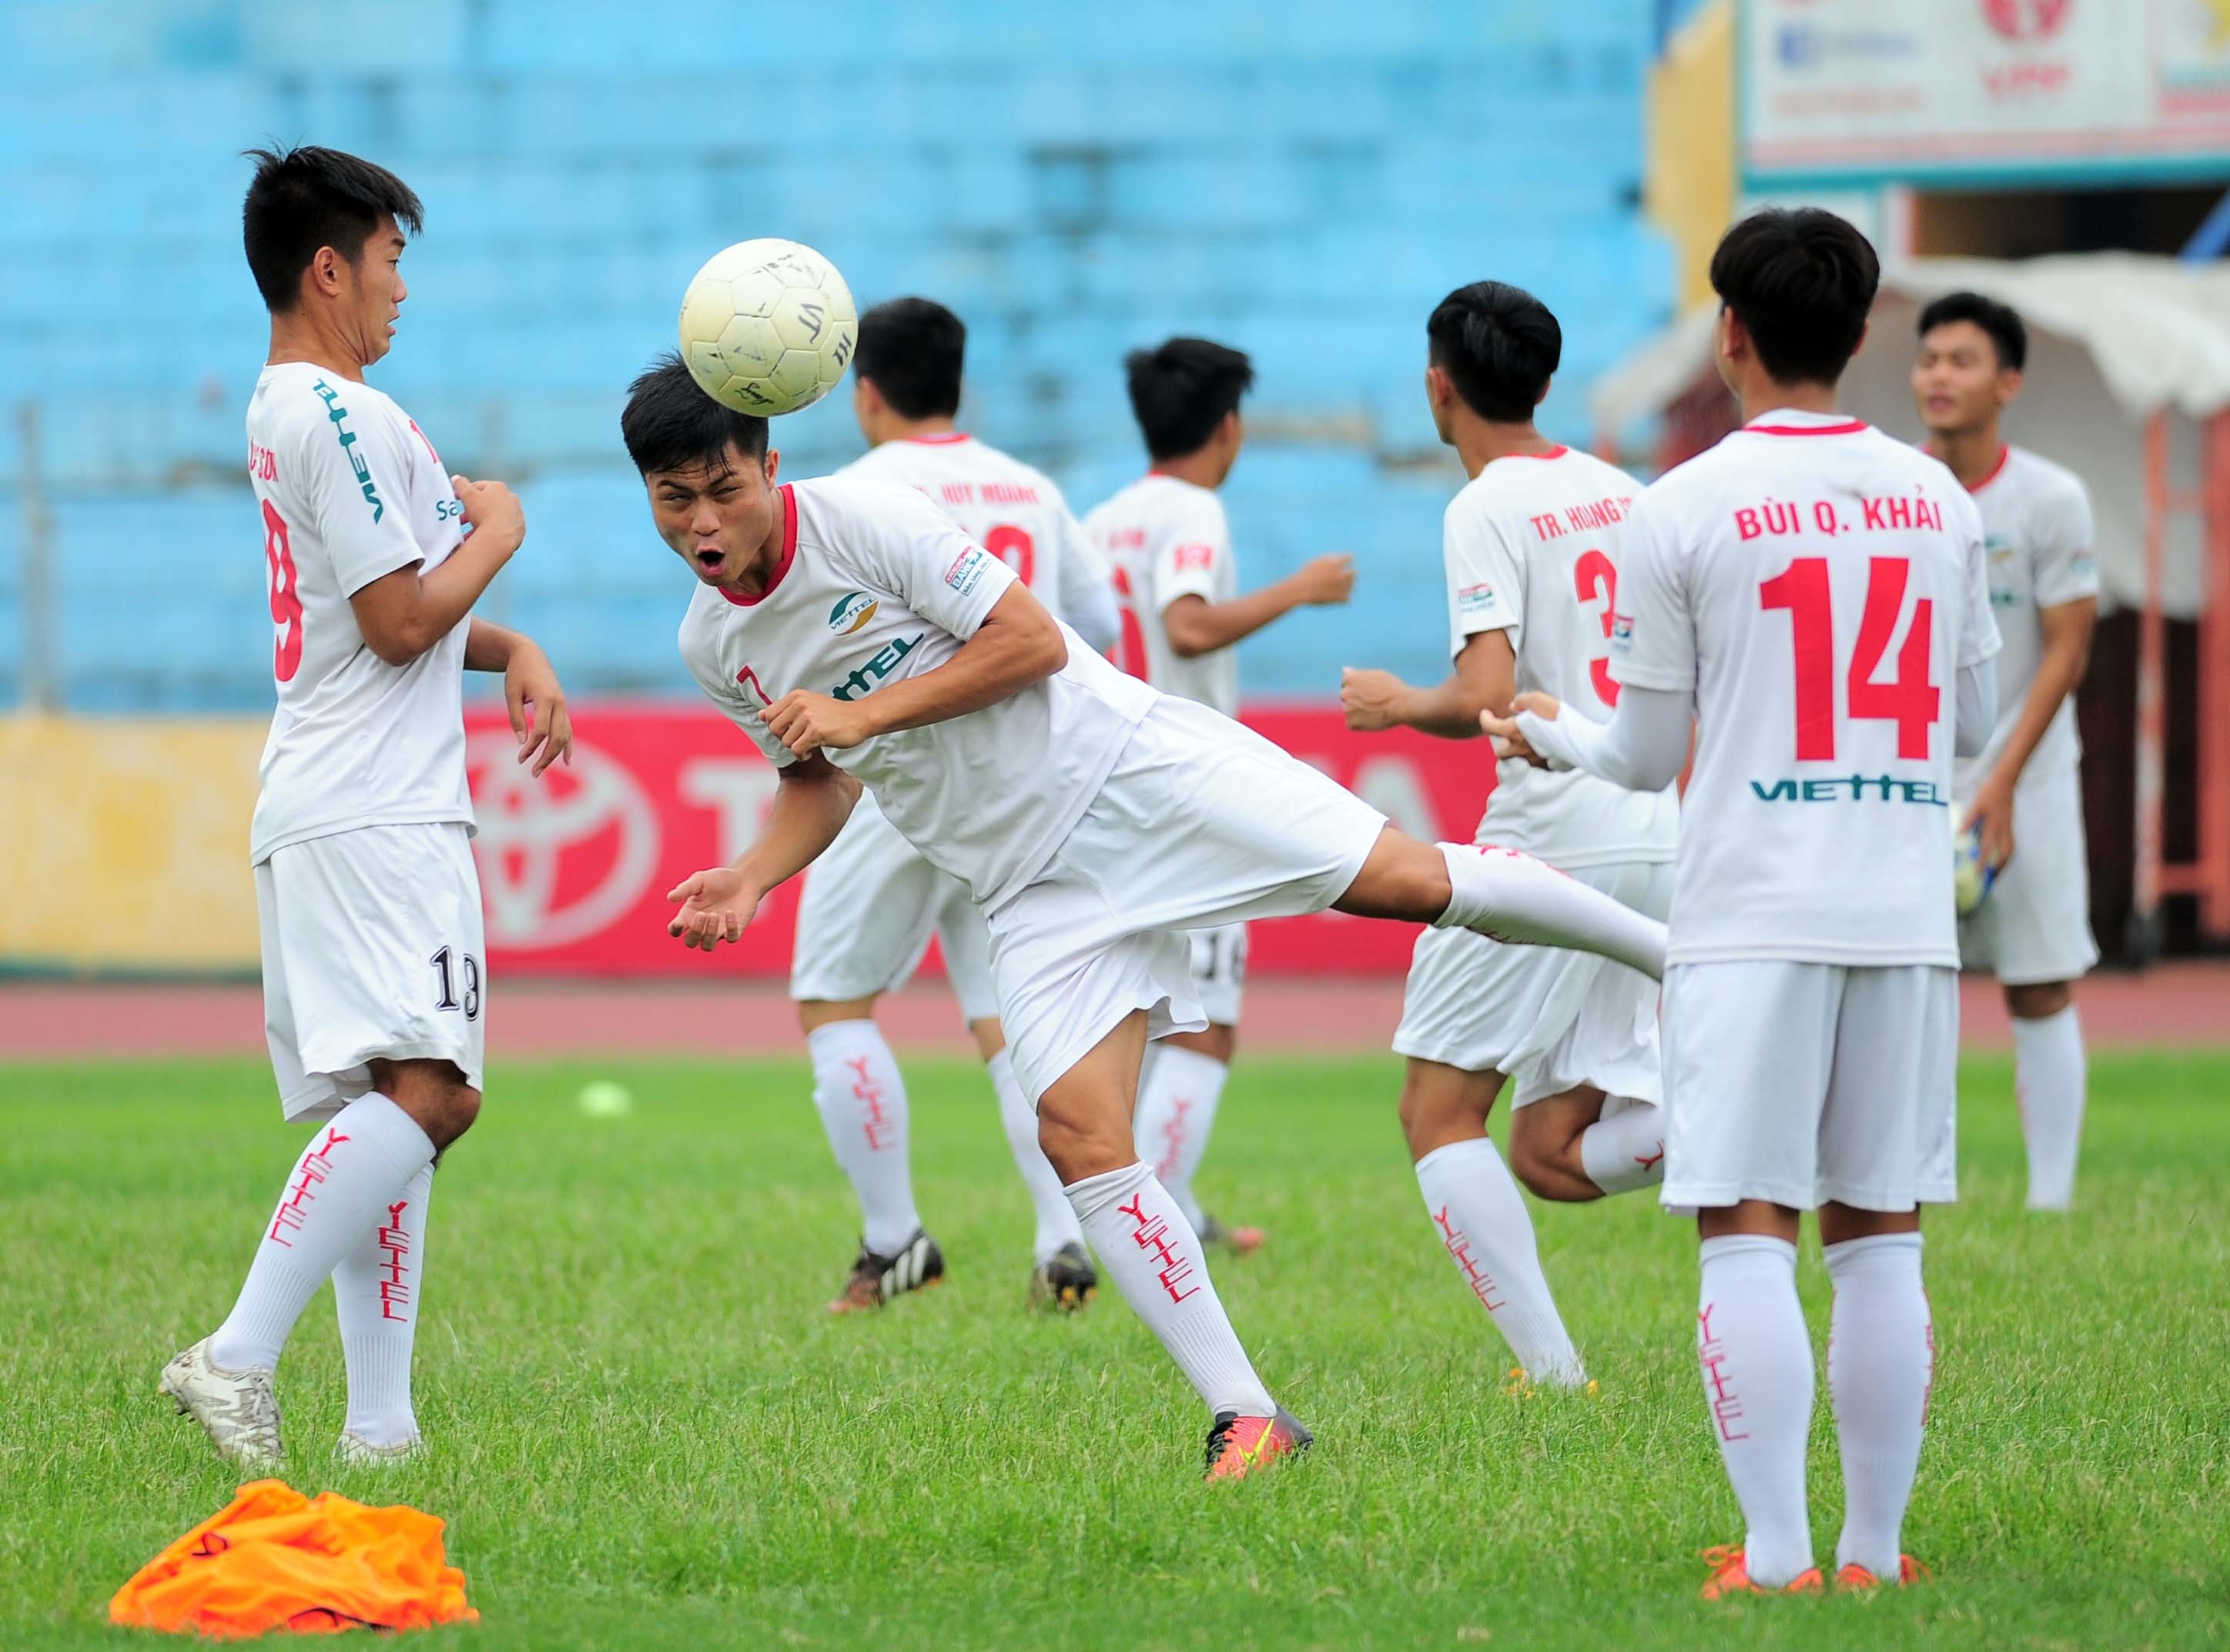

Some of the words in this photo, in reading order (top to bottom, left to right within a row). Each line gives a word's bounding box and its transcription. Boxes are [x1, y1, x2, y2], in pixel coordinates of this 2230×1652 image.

[1734, 496, 1801, 541] BÙI
[1813, 500, 1850, 538] Q.
[1861, 483, 1943, 533] KHẢI
[831, 598, 876, 630] VIETTEL
[1760, 557, 1940, 761] 14
[1751, 774, 1949, 807] VIETTEL
